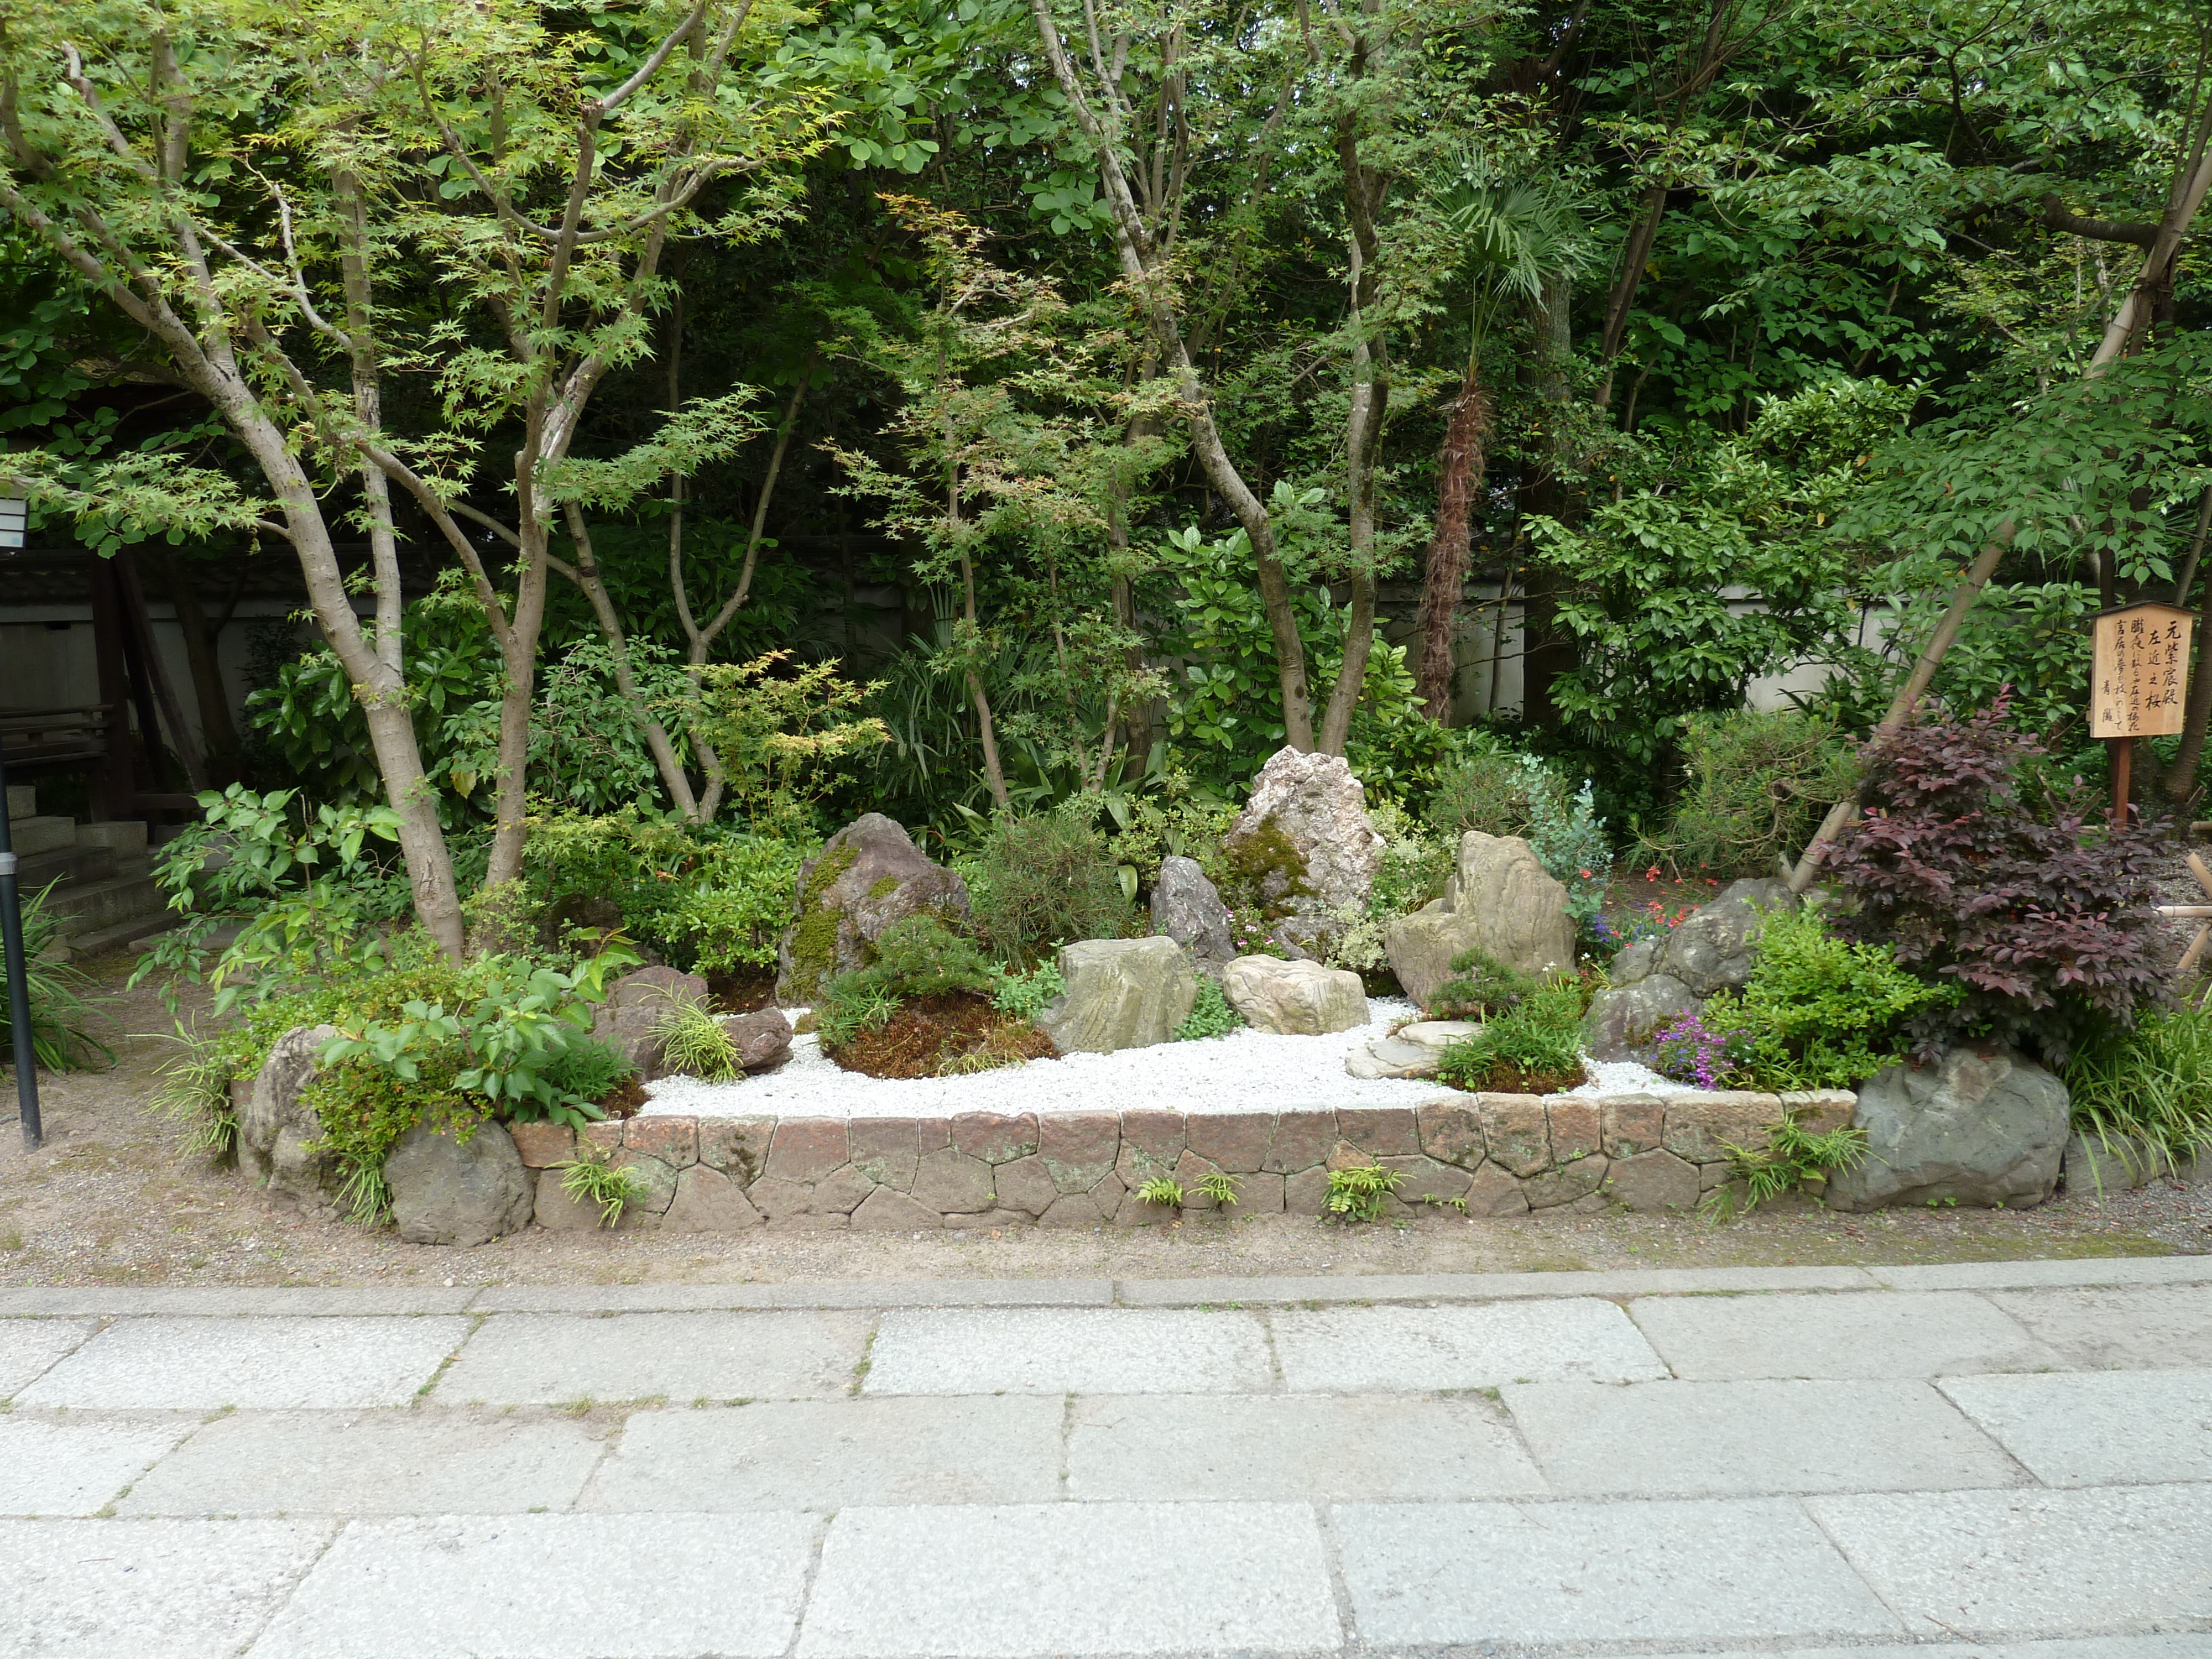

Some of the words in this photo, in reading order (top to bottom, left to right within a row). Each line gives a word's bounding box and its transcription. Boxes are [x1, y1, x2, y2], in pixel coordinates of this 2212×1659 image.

[2145, 629, 2161, 711] 左近之桜
[2162, 620, 2181, 705] 元紫宸殿
